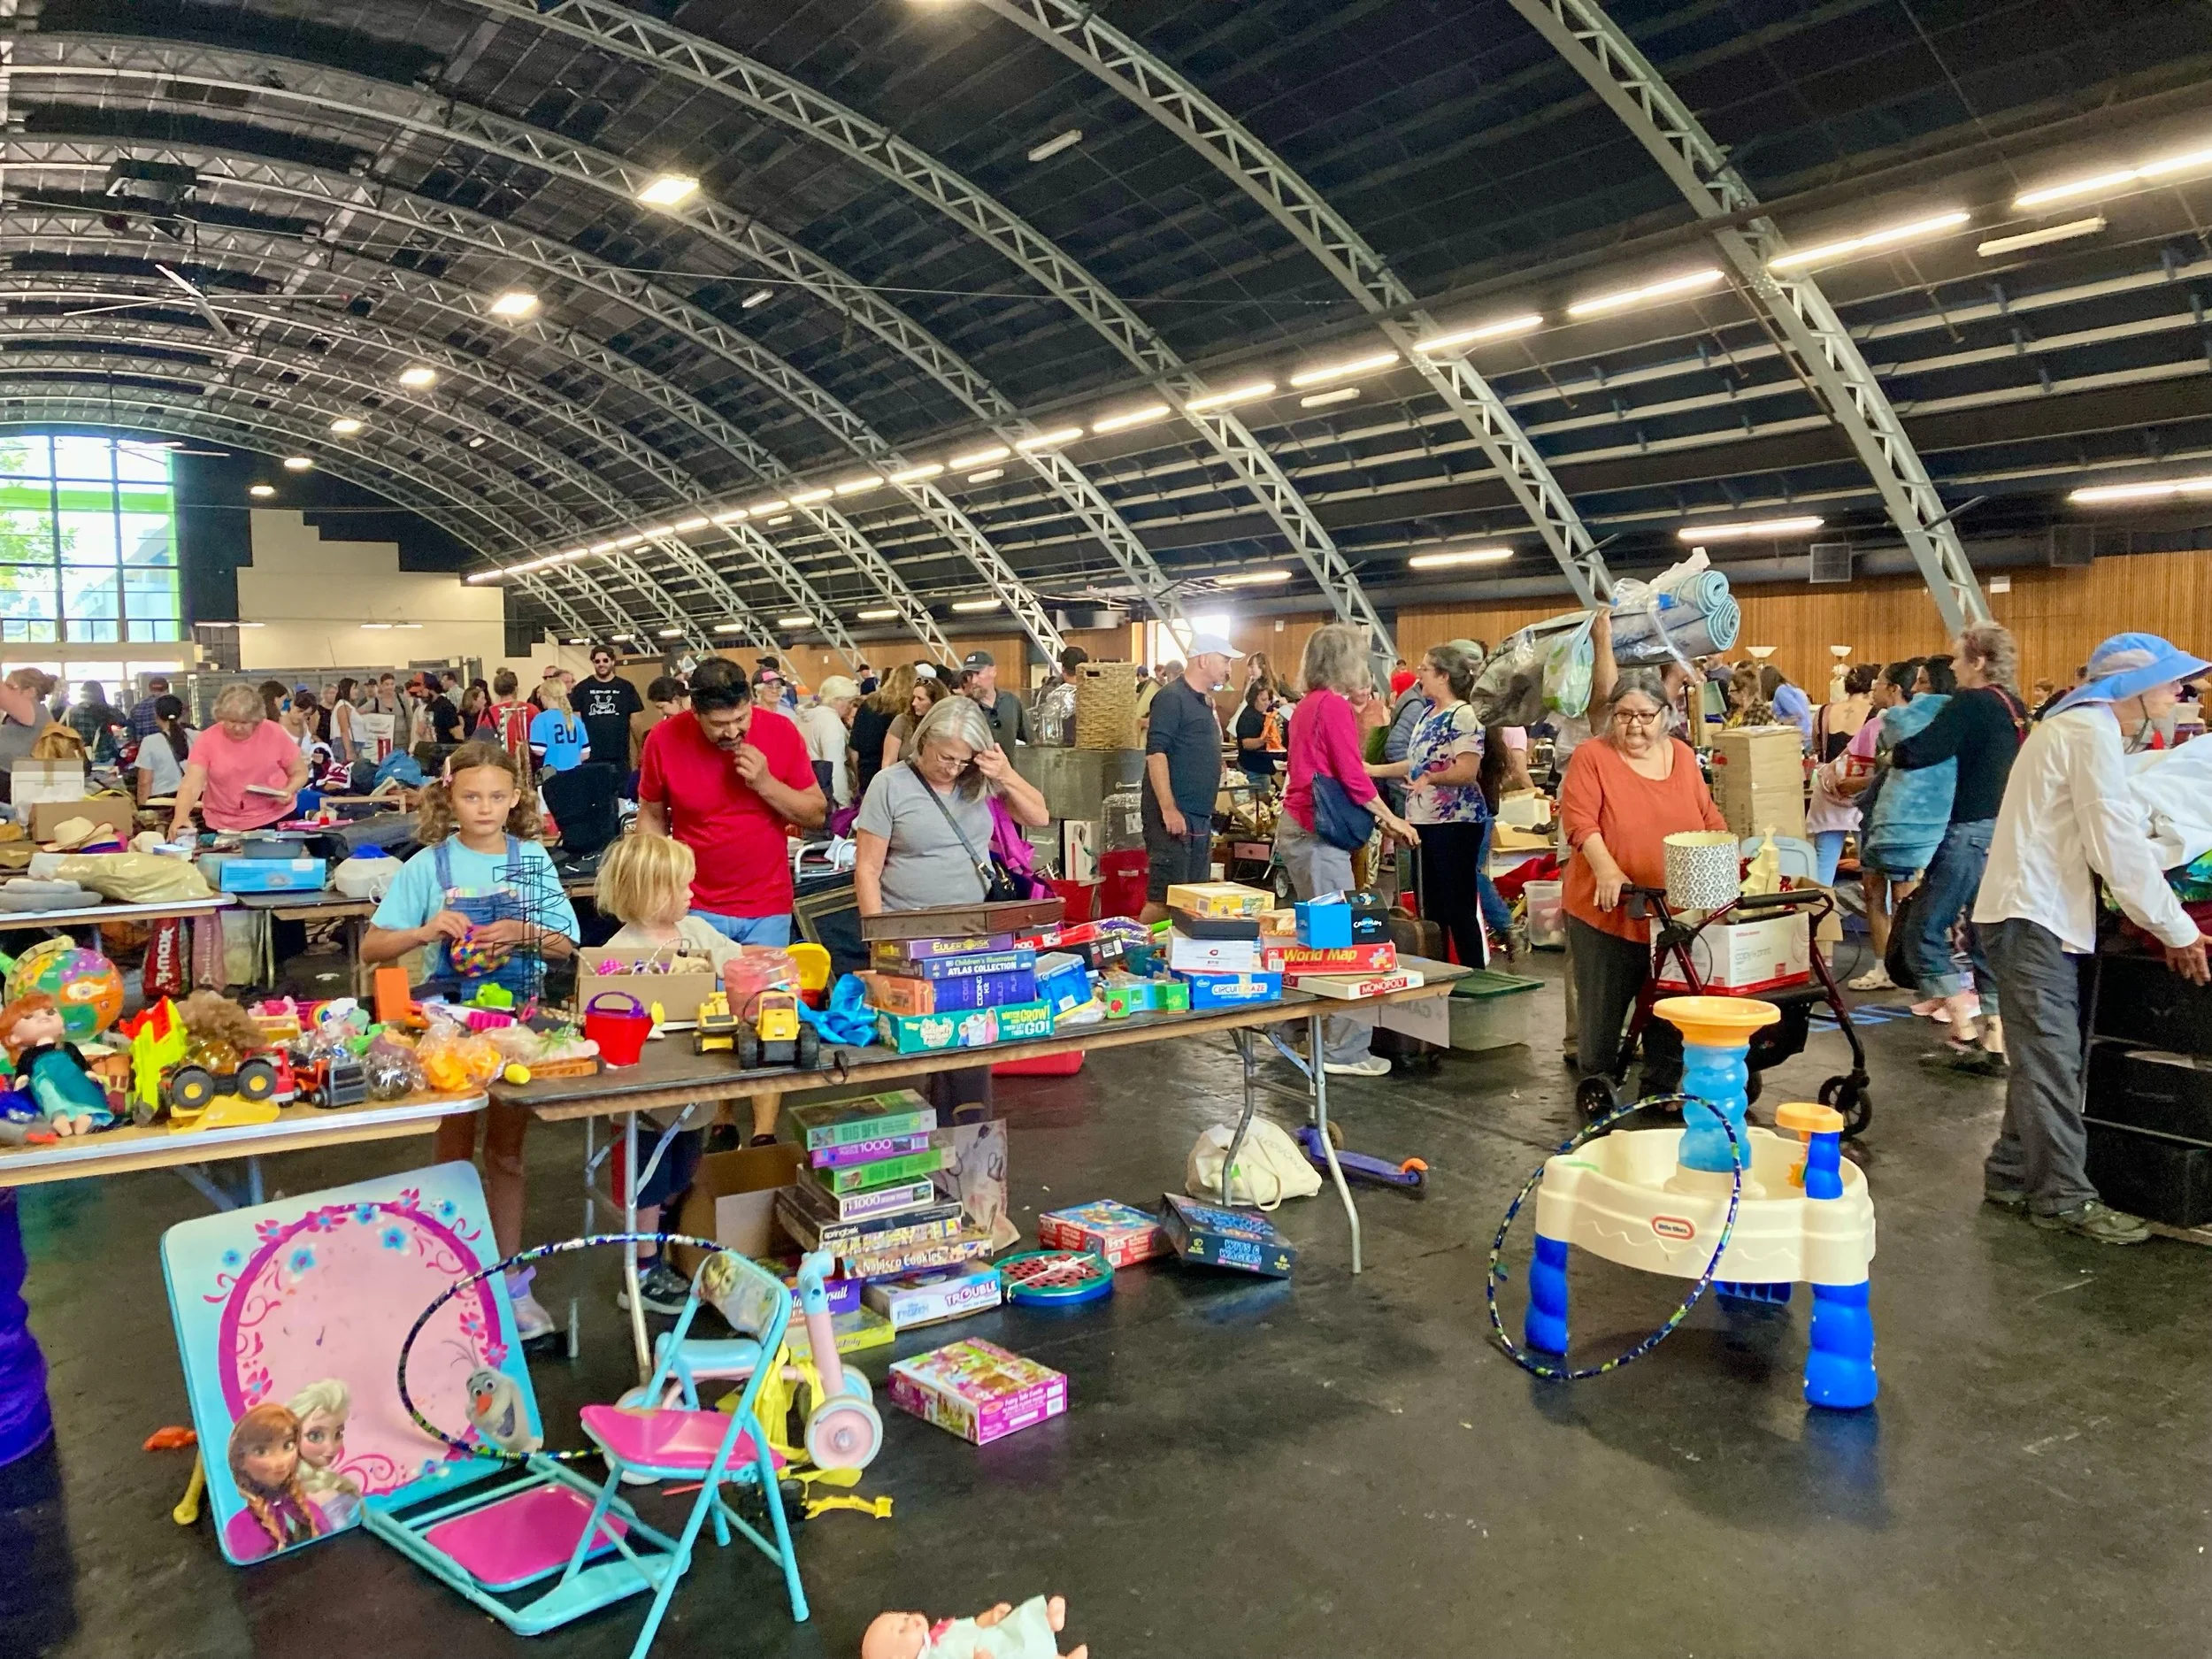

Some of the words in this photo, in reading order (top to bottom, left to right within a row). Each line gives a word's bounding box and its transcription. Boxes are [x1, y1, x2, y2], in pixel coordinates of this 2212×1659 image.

[1283, 949, 1324, 963] World
[1327, 949, 1357, 963] Map
[947, 965, 972, 976] ATLAS
[973, 961, 1018, 973] COLLECTION
[1362, 977, 1407, 995] MONOPOLY
[1020, 1004, 1050, 1023] GROW!
[1024, 1020, 1050, 1035] GO!
[859, 1138, 892, 1154] 1000
[854, 1194, 880, 1210] 1000
[1224, 1239, 1251, 1252] WITS
[863, 1256, 902, 1272] Nabisco
[903, 1250, 942, 1267] Cookies
[1218, 1248, 1263, 1264] WAGERS
[945, 1279, 998, 1307] TROUBLE
